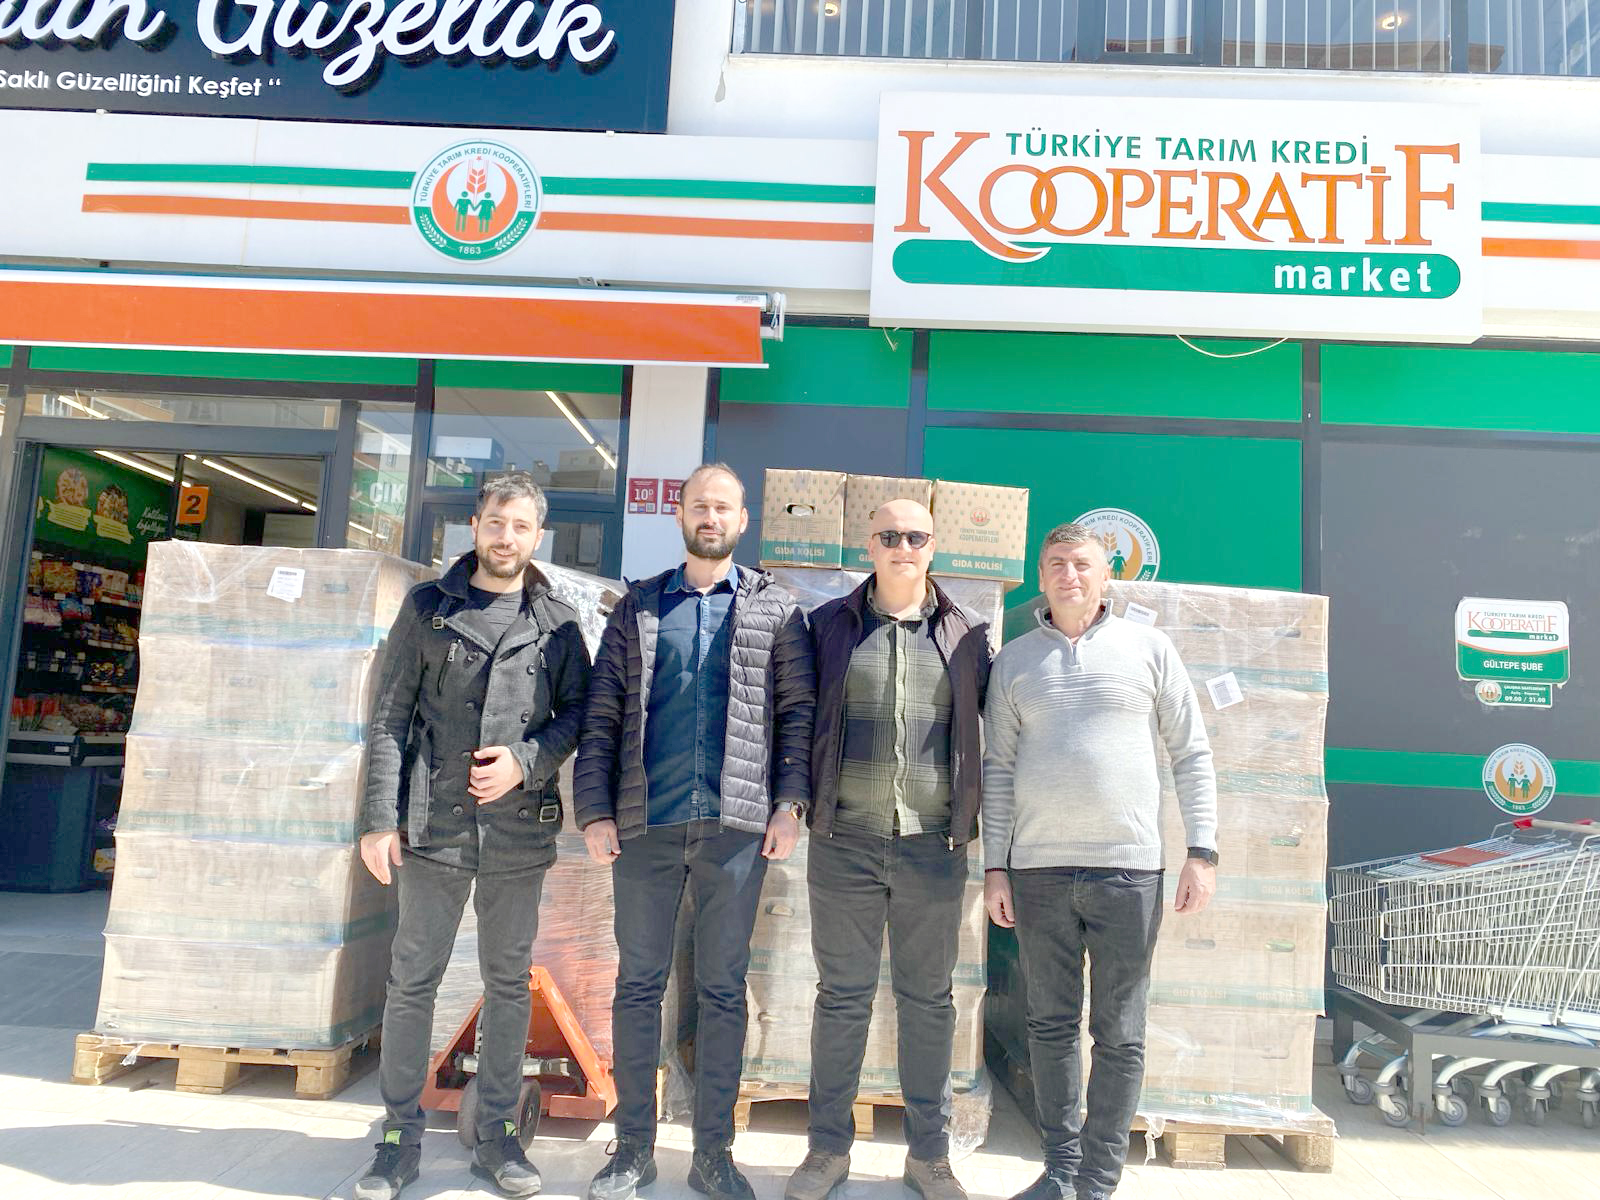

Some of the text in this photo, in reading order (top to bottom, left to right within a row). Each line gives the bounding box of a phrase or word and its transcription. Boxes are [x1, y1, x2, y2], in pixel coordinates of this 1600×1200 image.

[56, 71, 180, 97] Güzelliğini
[188, 76, 262, 99] Keşfet
[1005, 127, 1368, 164] TÜRKİYE TARIM KREDİ
[420, 167, 439, 202] TÜRKİYE
[438, 151, 462, 168] TARIM
[464, 147, 491, 156] KREDİ
[893, 130, 1460, 259] KOOPERATİF
[459, 246, 481, 255] 1863
[1274, 257, 1432, 293] market
[185, 495, 202, 515] 2
[951, 559, 973, 568] GIDA
[1483, 659, 1543, 672] GÜLTEPE ŞUBE
